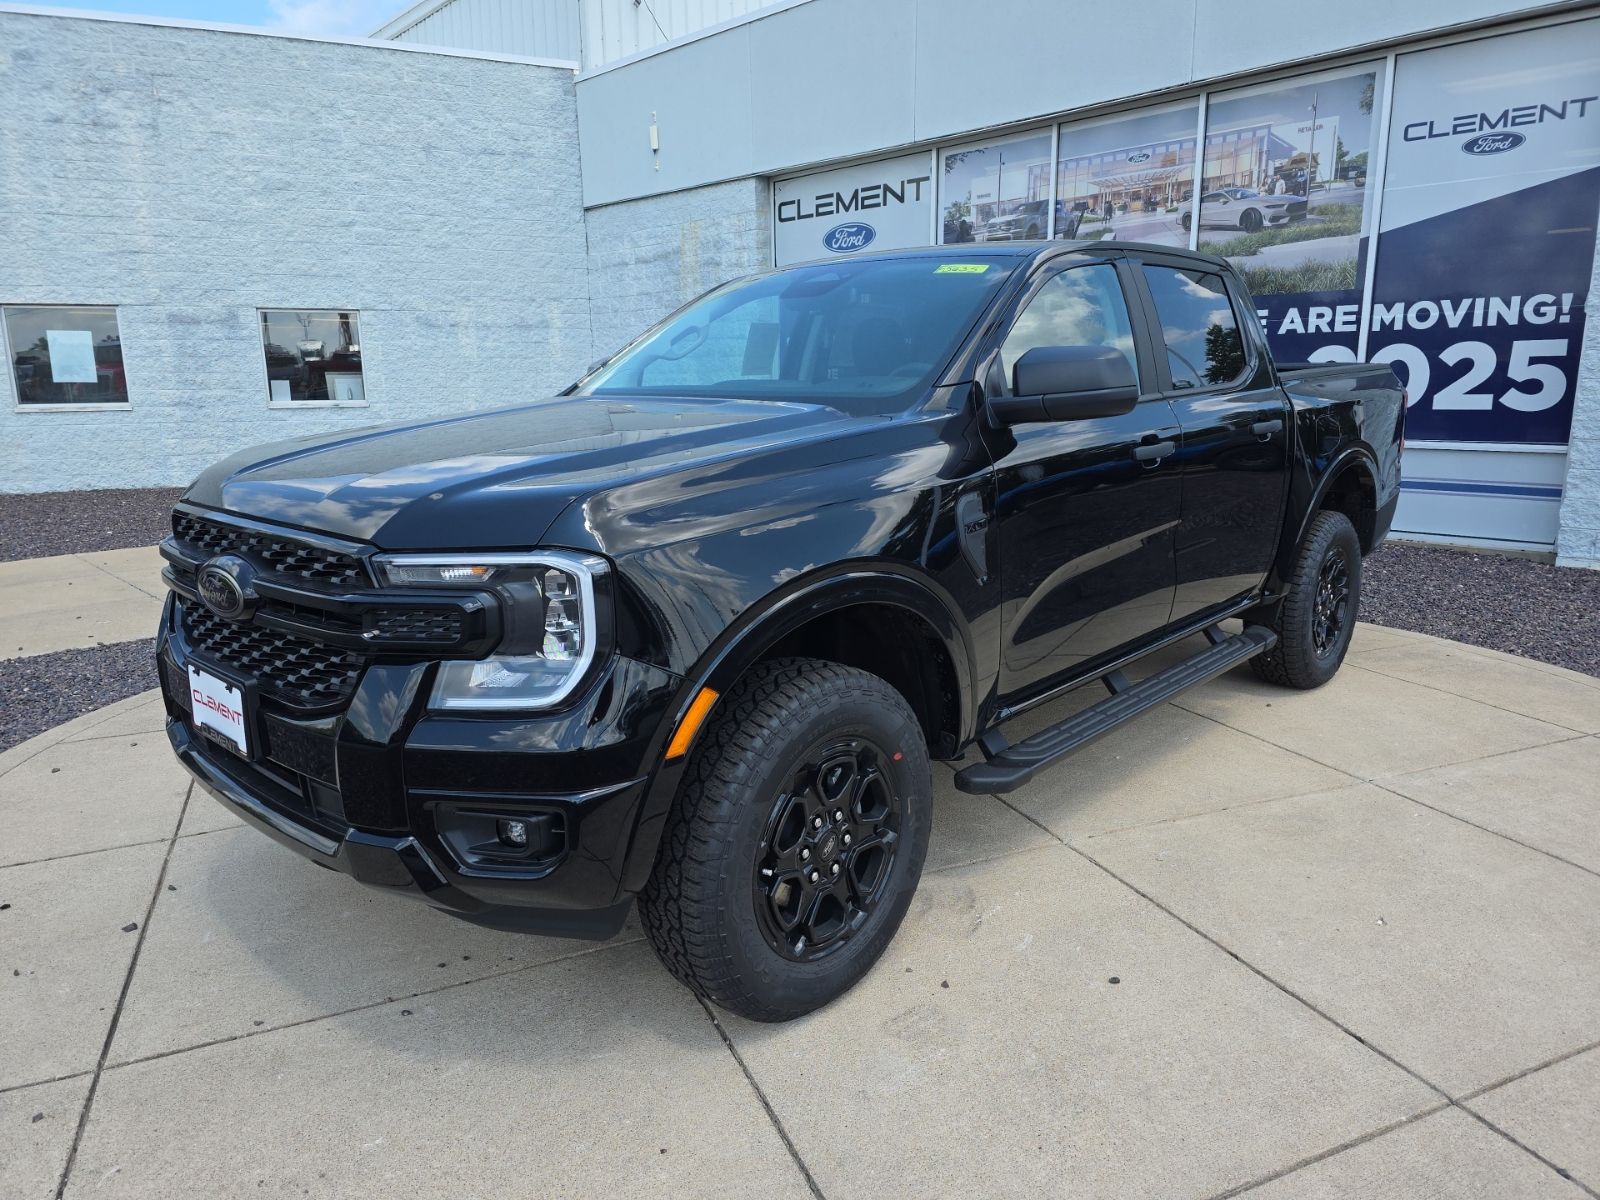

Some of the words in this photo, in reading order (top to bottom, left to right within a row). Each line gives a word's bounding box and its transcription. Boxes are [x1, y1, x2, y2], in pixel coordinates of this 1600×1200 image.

[1403, 96, 1599, 142] CLEMENT
[1473, 135, 1512, 152] Ford
[778, 176, 930, 223] CLEMENT
[832, 227, 865, 248] Ford
[1278, 304, 1358, 335] ARE
[1371, 292, 1574, 332] MOVING!
[193, 689, 242, 725] CLEMENT
